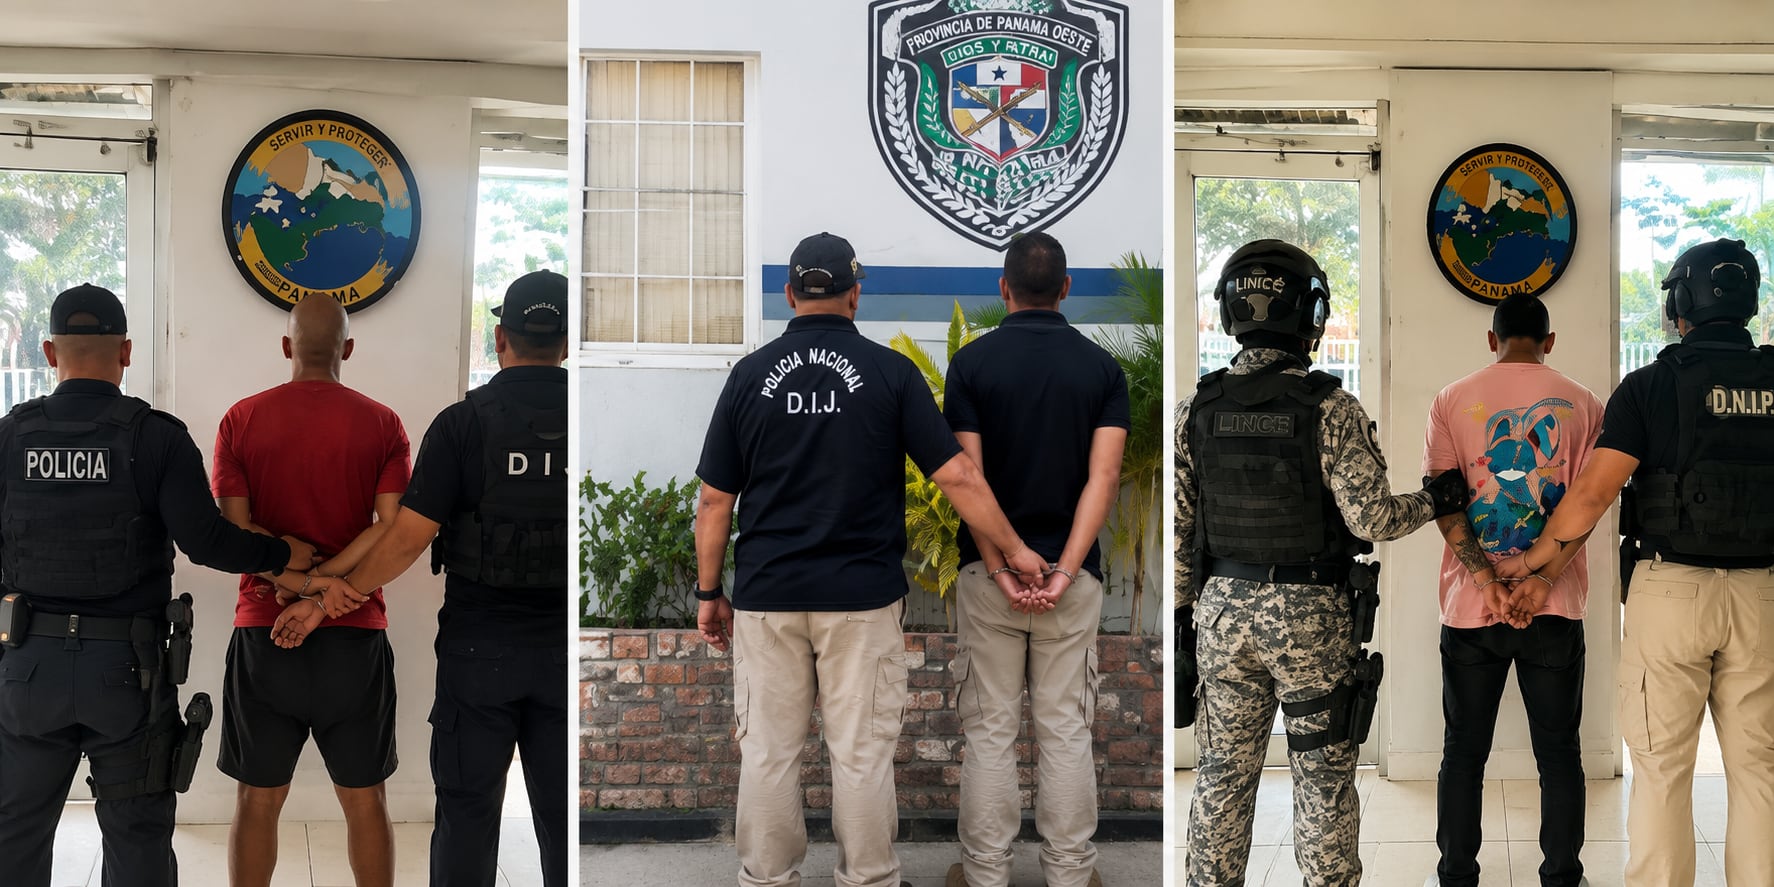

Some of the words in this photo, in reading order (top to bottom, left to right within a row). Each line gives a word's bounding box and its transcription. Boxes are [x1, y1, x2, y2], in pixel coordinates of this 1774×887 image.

[906, 18, 974, 56] PROVINCIA
[976, 16, 993, 31] DE
[997, 16, 1049, 37] PANAMA
[1052, 25, 1093, 53] OESTE
[991, 40, 1000, 51] Y
[270, 124, 314, 152] SERVIR
[318, 123, 326, 135] Y
[1460, 154, 1494, 177] SERVIR
[1497, 154, 1503, 164] Y
[277, 280, 361, 304] PAMA
[761, 351, 804, 399] POLICIA
[809, 348, 864, 393] NACIONAL
[787, 390, 841, 414] D.I.J.
[1219, 414, 1291, 434] LINCE
[27, 450, 107, 479] POLICIA
